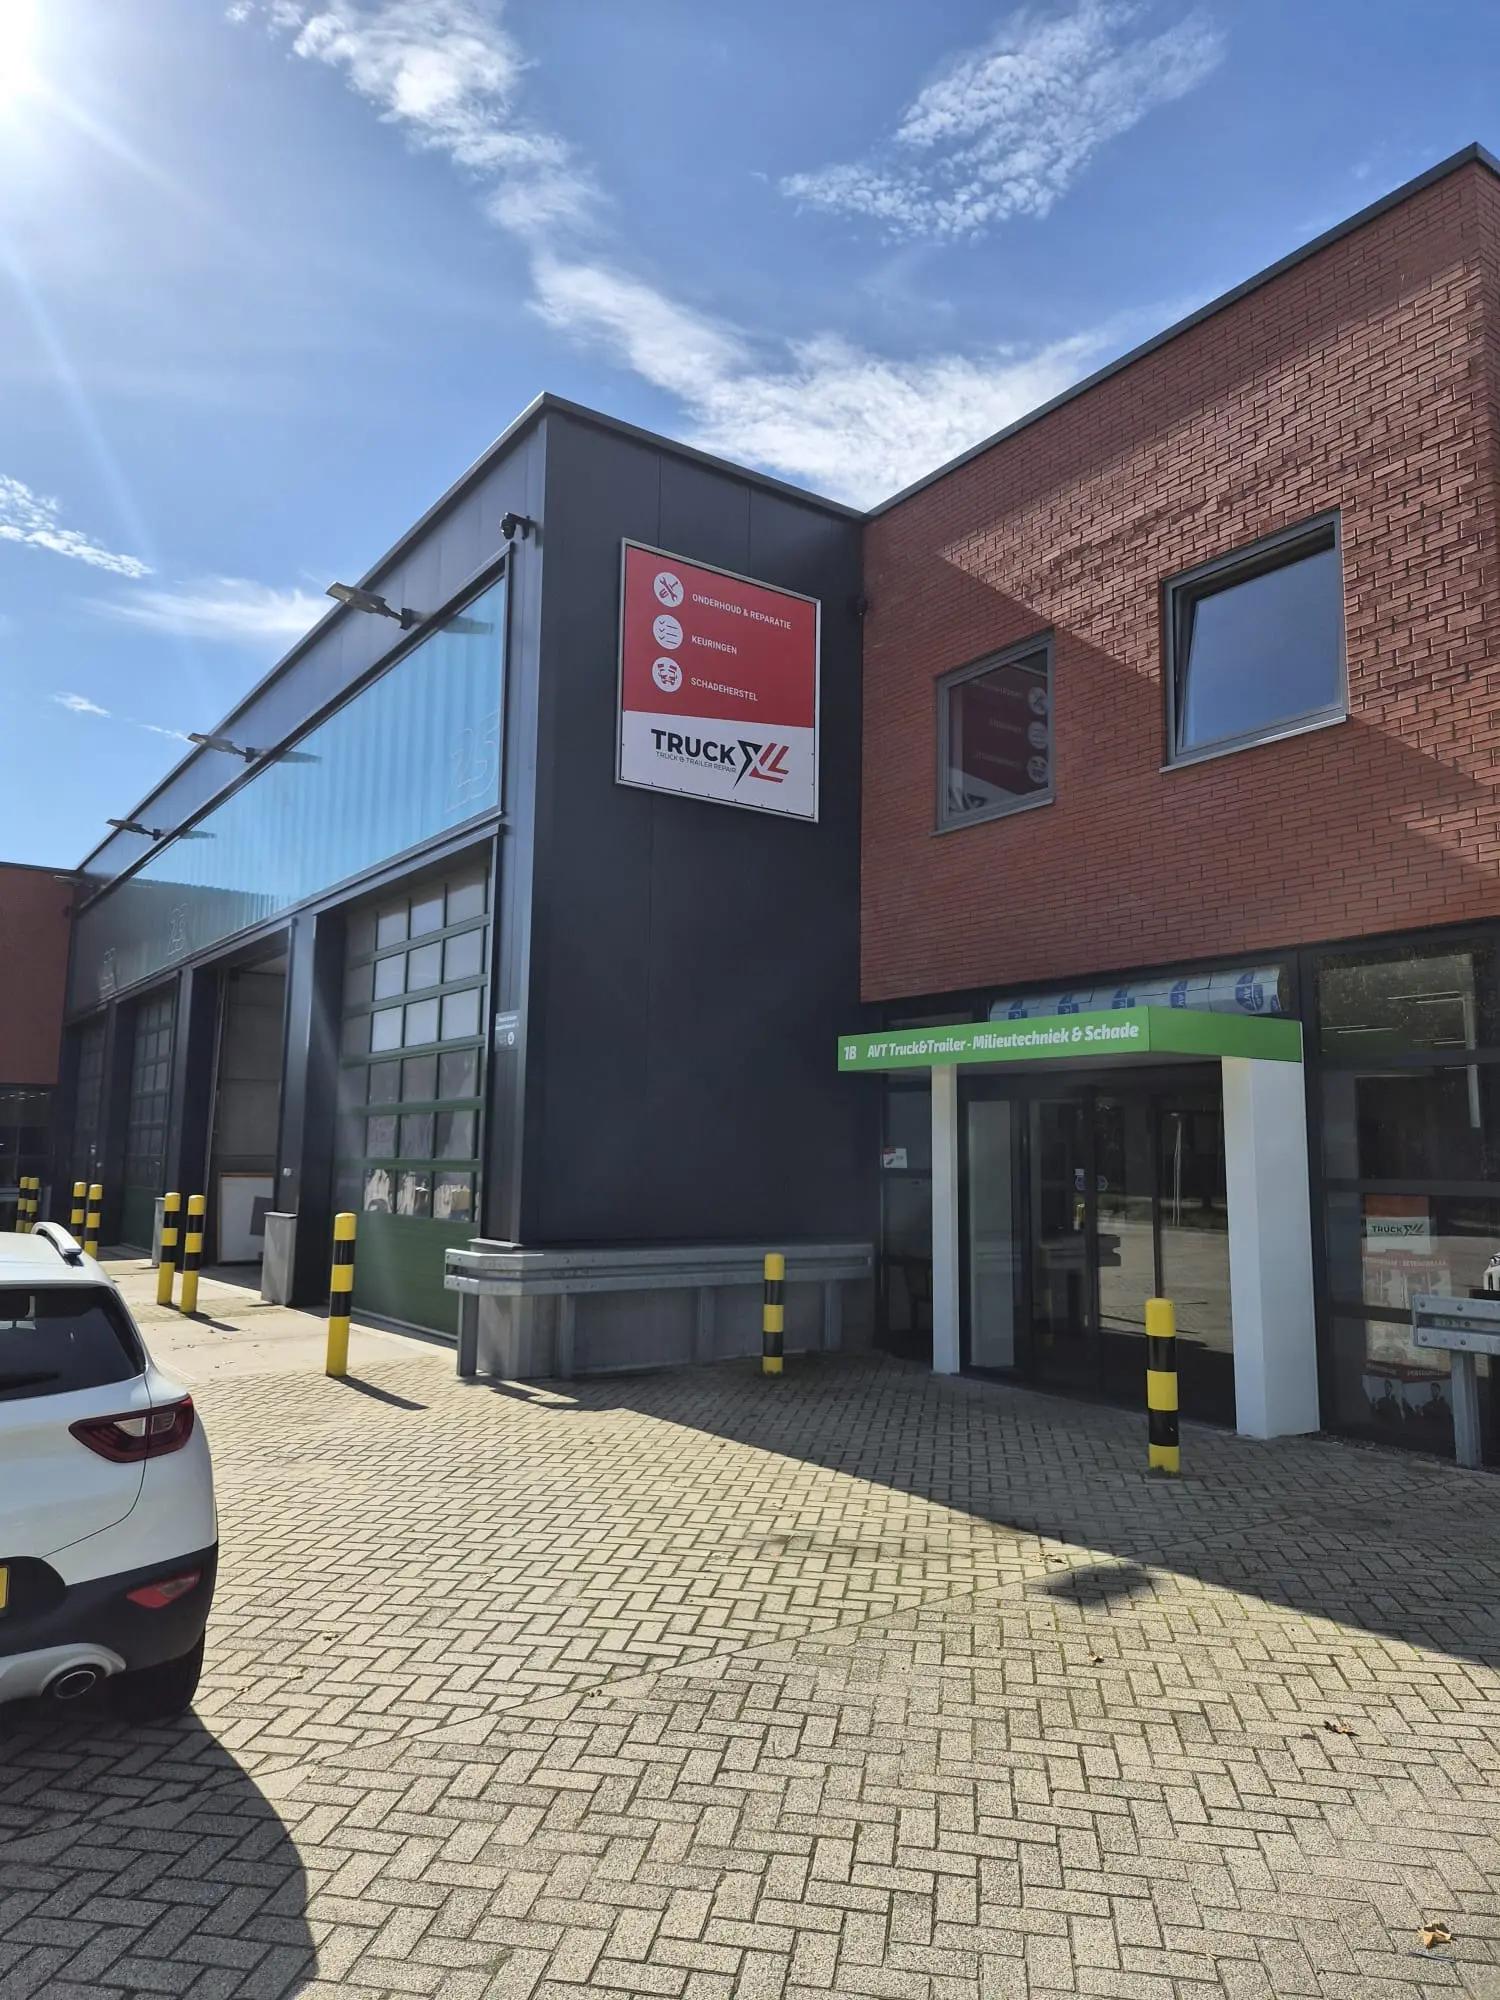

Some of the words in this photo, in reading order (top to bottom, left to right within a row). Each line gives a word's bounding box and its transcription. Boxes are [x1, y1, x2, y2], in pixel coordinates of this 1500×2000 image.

[692, 593, 742, 615] ONDERHOUD
[743, 608, 749, 617] &
[750, 611, 792, 630] REPARATIE
[691, 635, 738, 655] KEURINGEN
[690, 677, 758, 702] SCHADEHERSTEL
[656, 751, 678, 762] TRUCK
[685, 757, 712, 768] TRAILER
[714, 763, 736, 774] REPAIR
[866, 1043, 888, 1059] AVT
[1071, 1026, 1082, 1042] &
[1084, 1022, 1139, 1041] Schade
